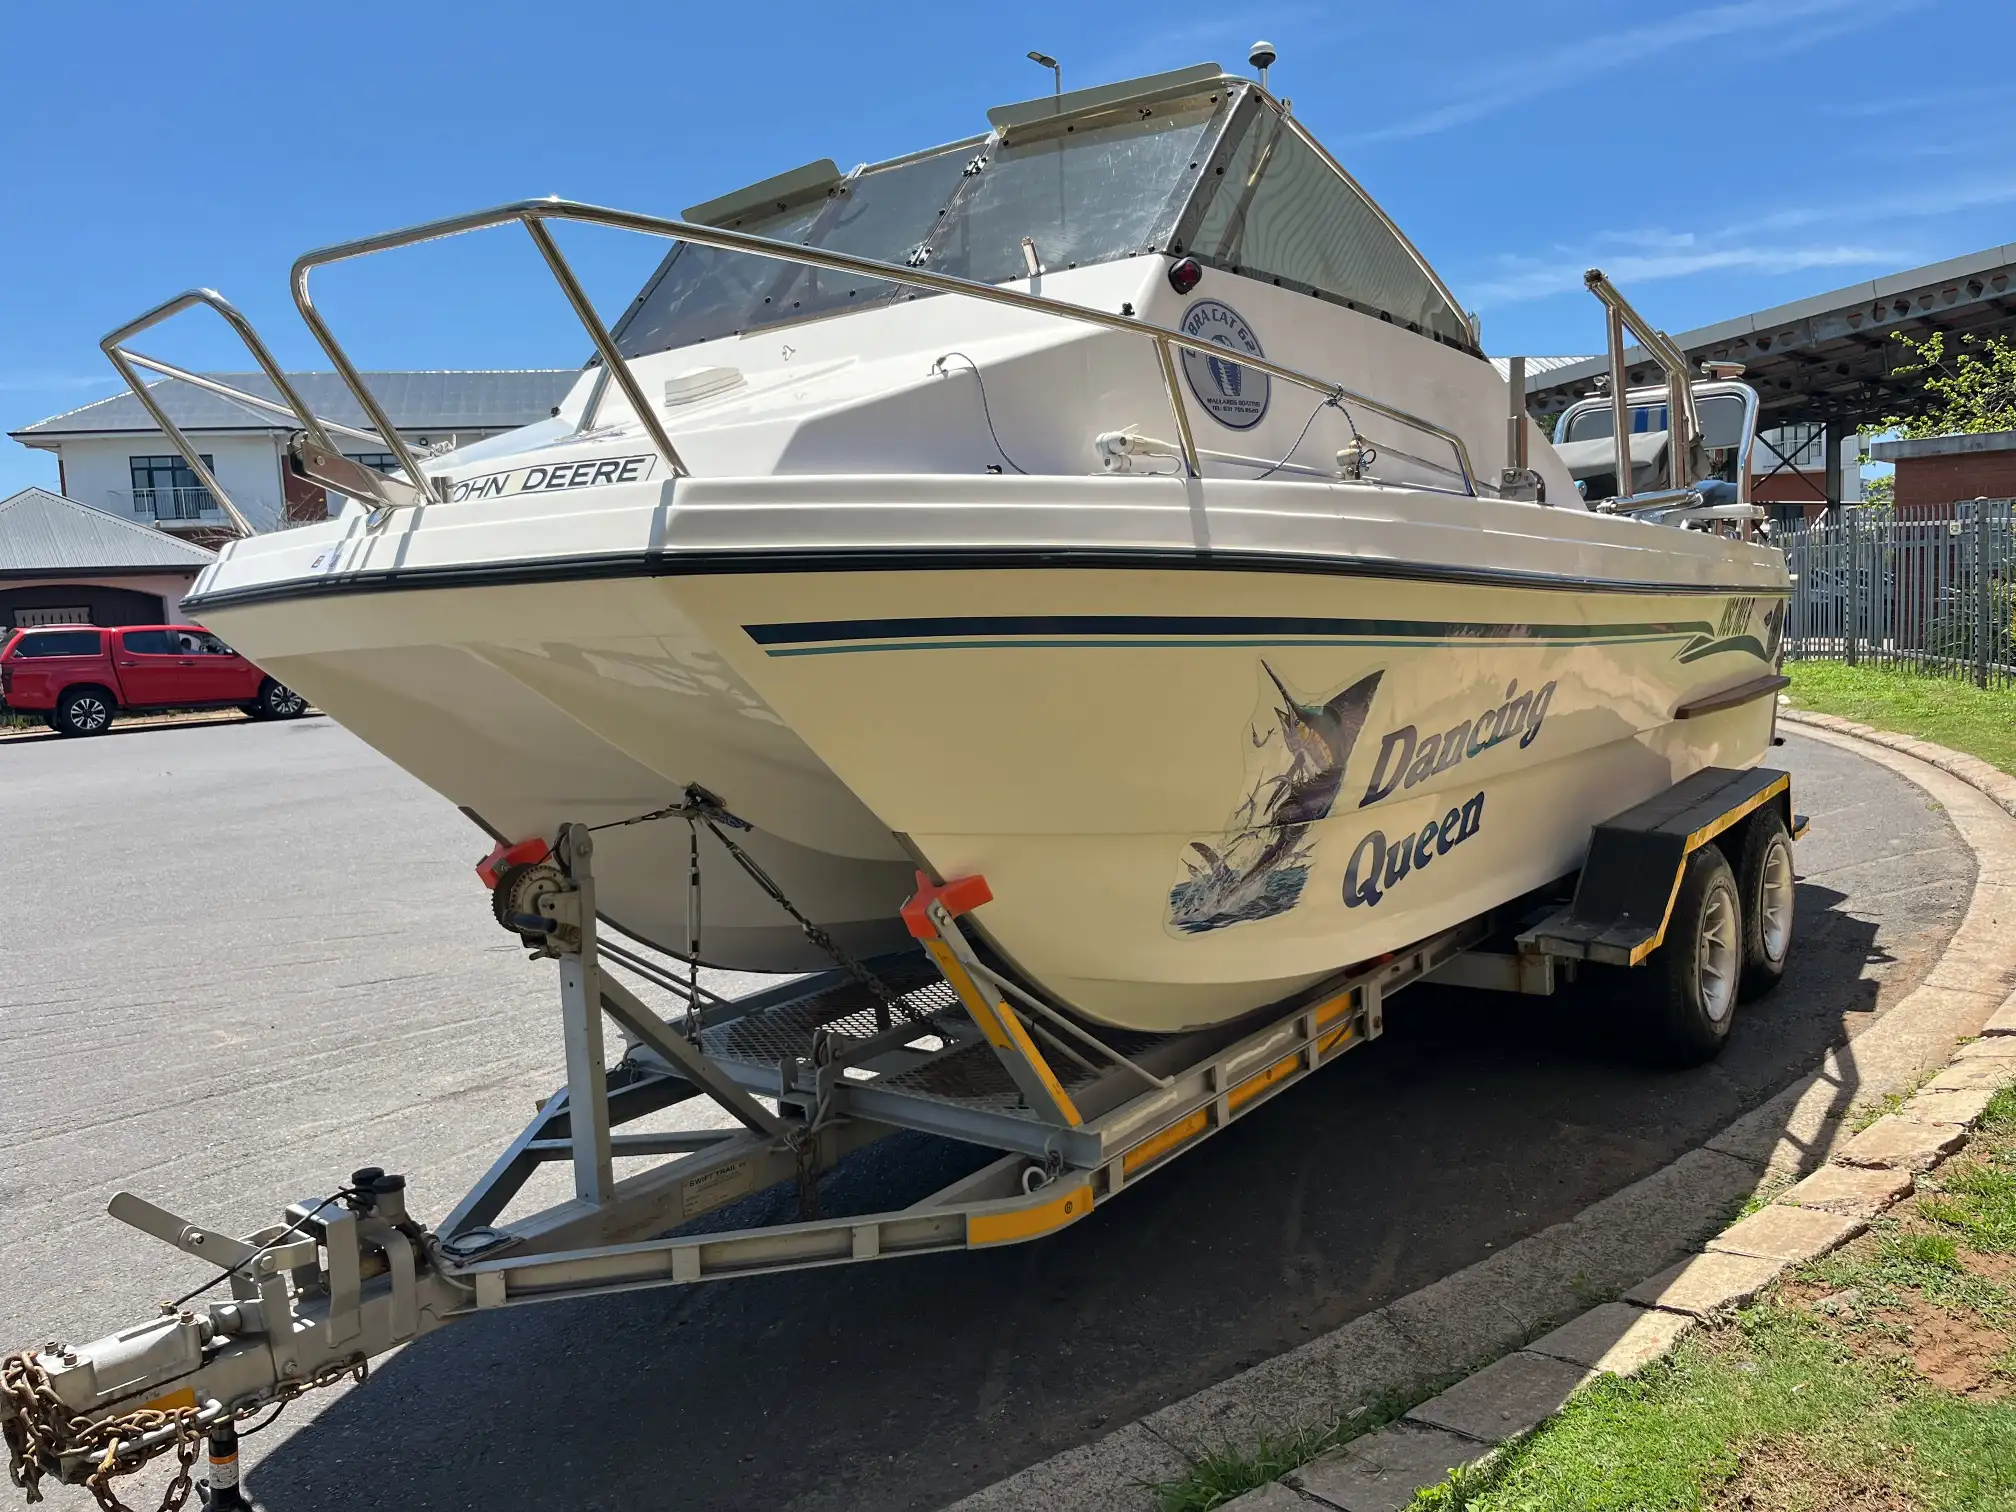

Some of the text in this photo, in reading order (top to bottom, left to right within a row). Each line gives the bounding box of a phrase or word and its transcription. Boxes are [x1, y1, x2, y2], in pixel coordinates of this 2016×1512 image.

[1211, 308, 1238, 329] CAT
[520, 457, 647, 492] DEERE
[1358, 677, 1558, 809] Dancing
[1342, 790, 1485, 909] Queen
[689, 1173, 713, 1187] SWIFT
[716, 1165, 738, 1177] TRAIL
